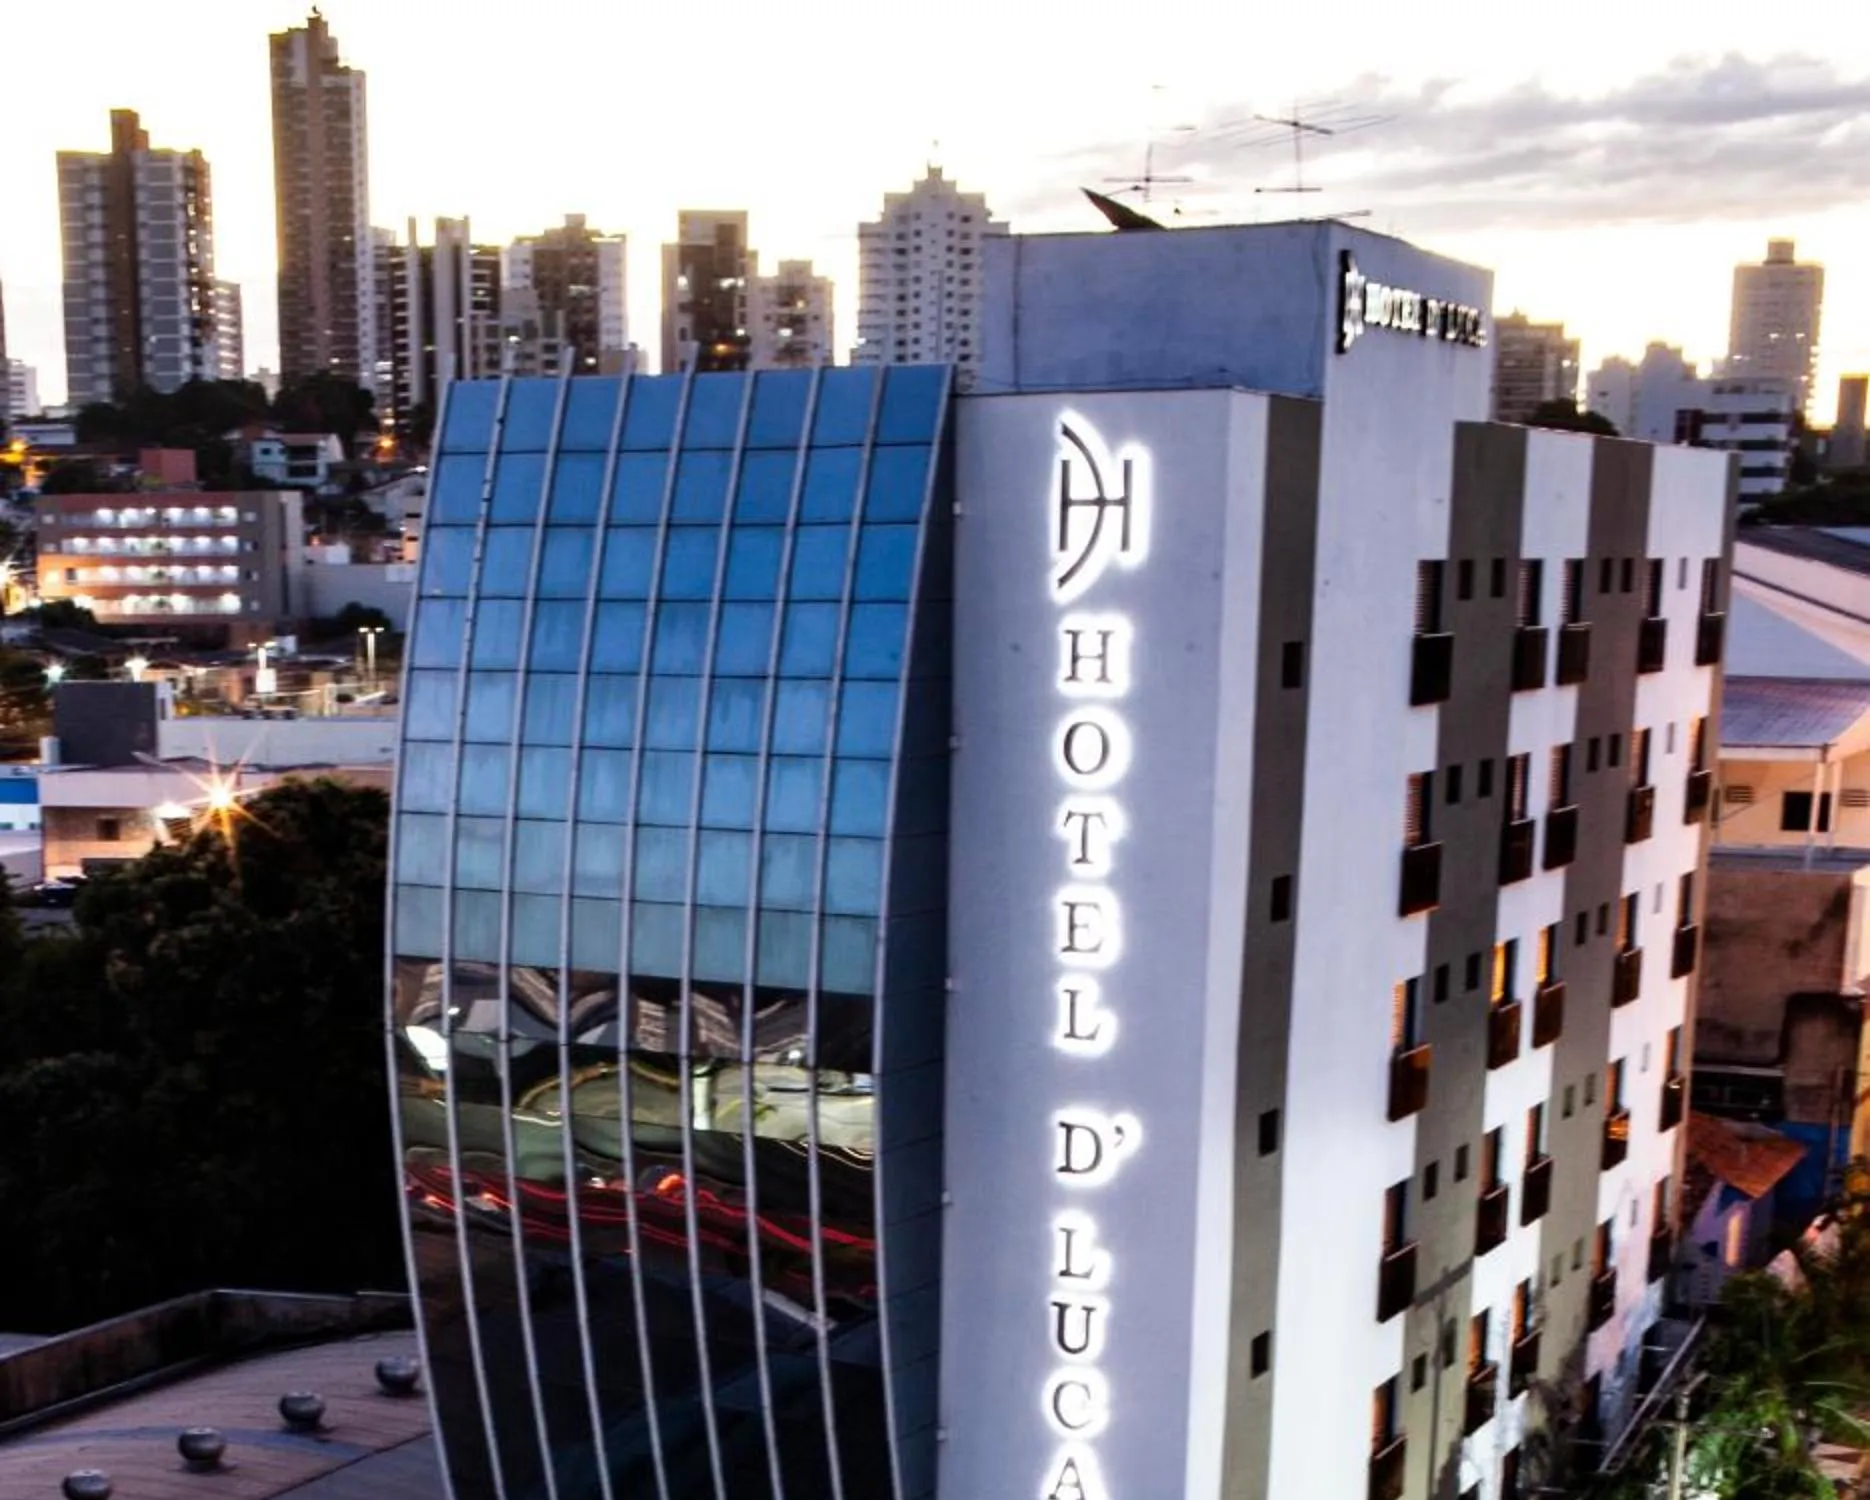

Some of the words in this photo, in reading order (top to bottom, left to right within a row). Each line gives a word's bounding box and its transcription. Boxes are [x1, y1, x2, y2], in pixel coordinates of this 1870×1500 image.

[1364, 282, 1421, 331] HOTEL
[1060, 627, 1115, 1042] HOTEL
[1056, 1120, 1126, 1175] D'
